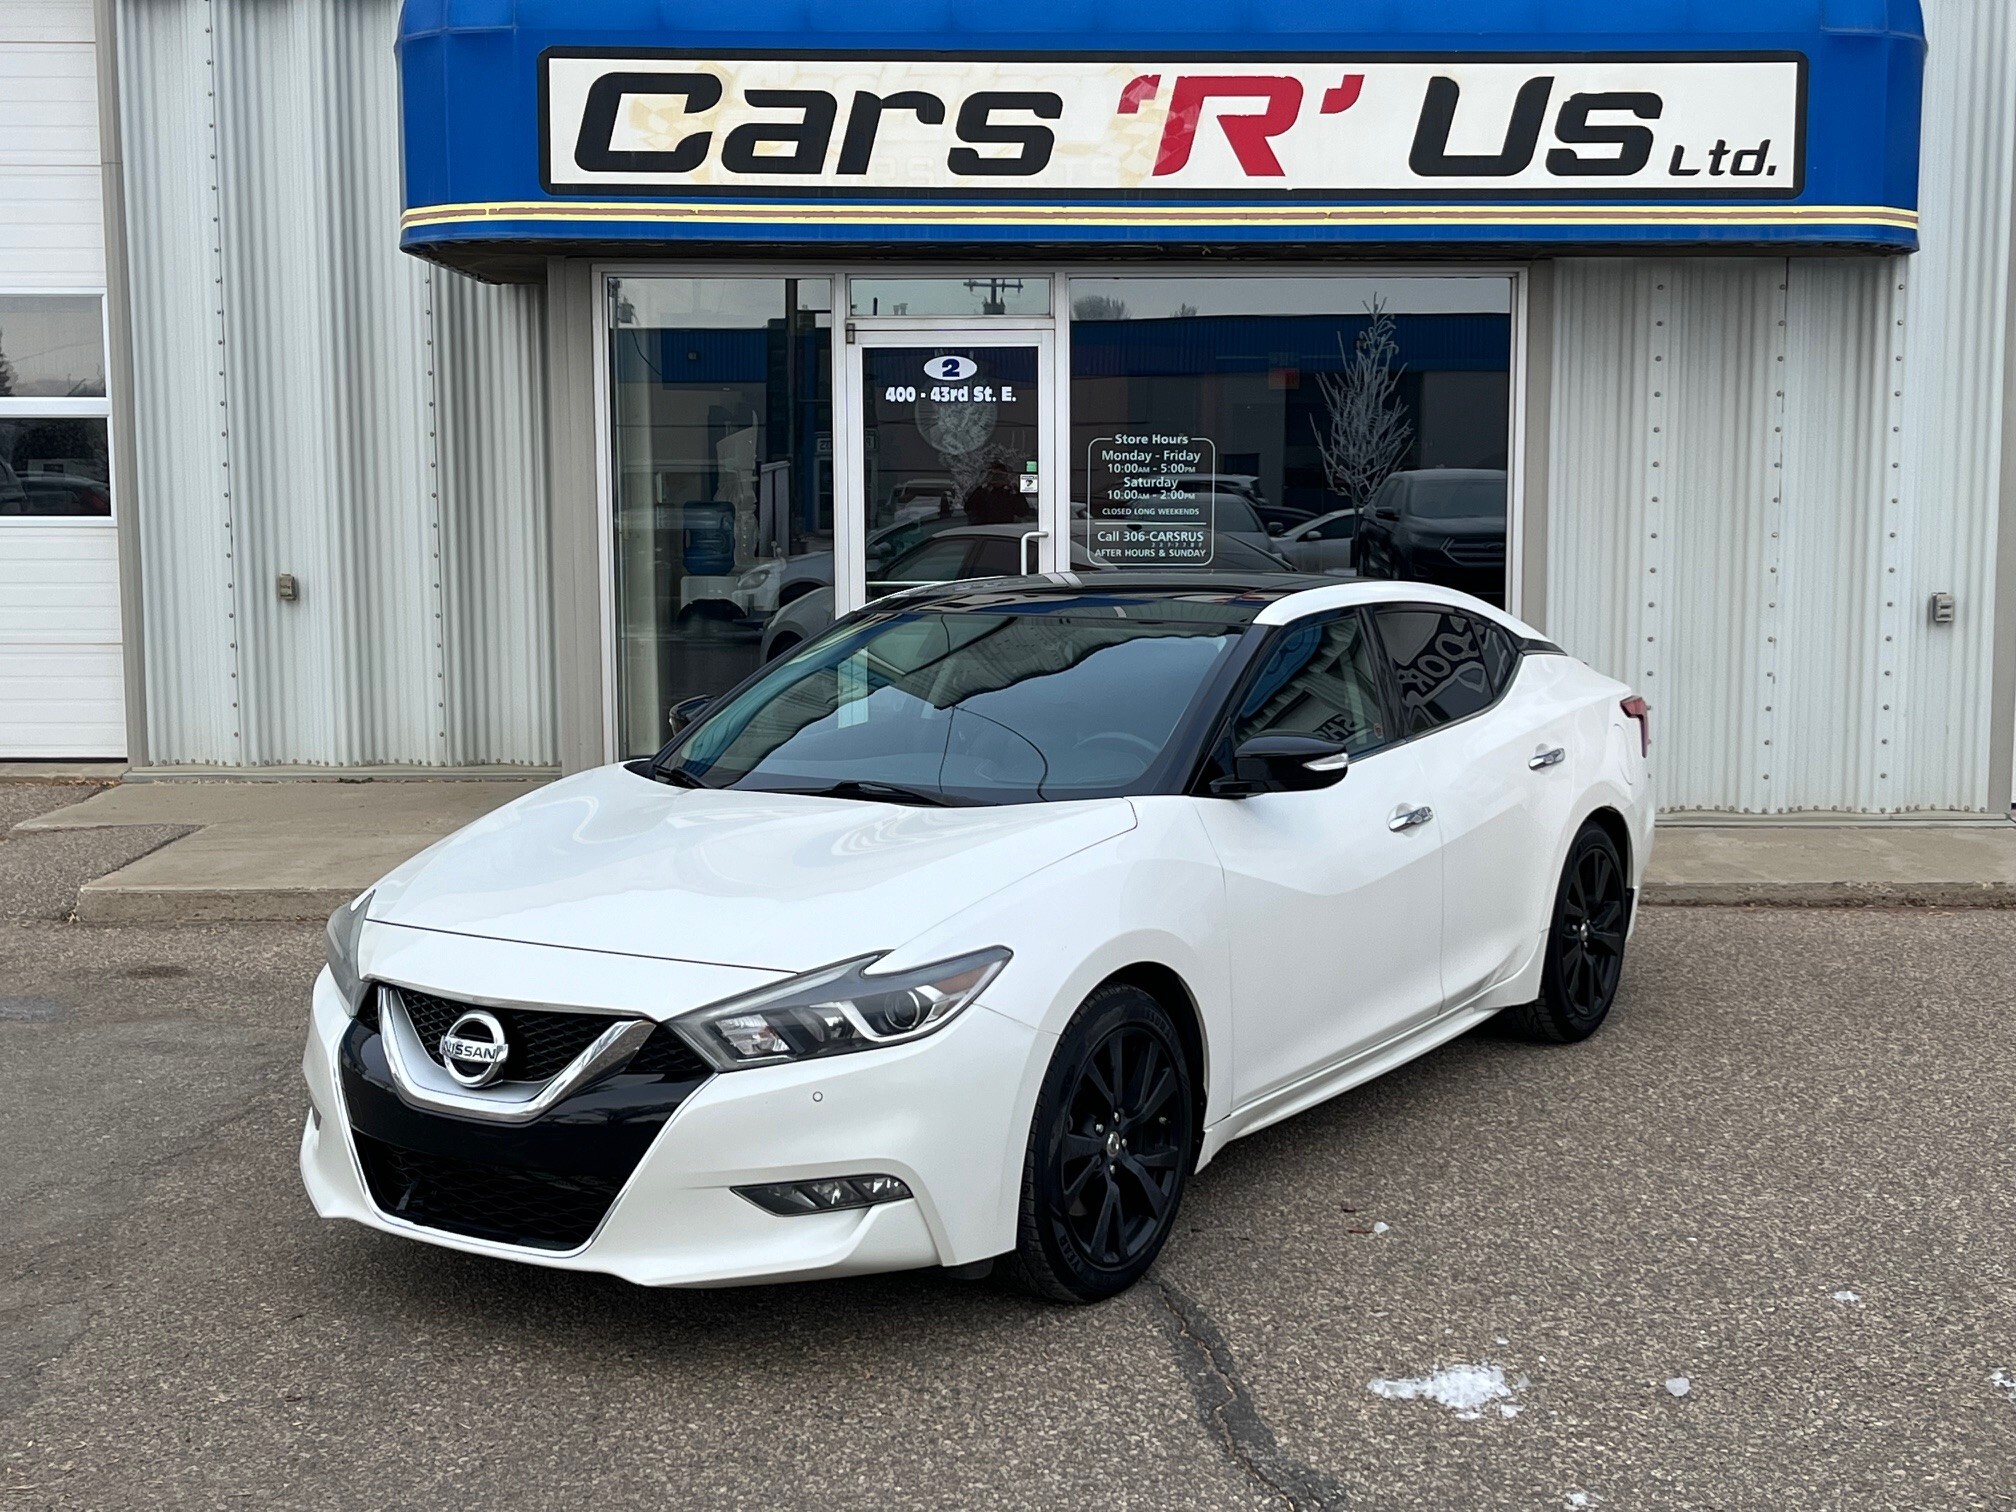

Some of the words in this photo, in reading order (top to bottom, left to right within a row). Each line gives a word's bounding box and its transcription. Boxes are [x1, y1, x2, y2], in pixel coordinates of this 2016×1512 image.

[574, 72, 1064, 177] Cars
[1408, 75, 1664, 177] Us
[1668, 138, 1778, 177] Ltd.
[941, 358, 960, 377] 2
[885, 386, 916, 402] 400
[930, 385, 969, 402] 43rd
[973, 385, 997, 402] St.
[1001, 386, 1017, 402] E.
[1114, 434, 1149, 444] Store
[1152, 434, 1189, 444] Hours
[1101, 450, 1153, 463] Monday
[1163, 449, 1201, 463] Friday
[1107, 463, 1150, 473] 10:00AM
[1160, 463, 1196, 473] 5:00PM
[1123, 476, 1179, 489] Saturday
[1107, 490, 1150, 500] 10:00AM
[1160, 490, 1196, 500] 2:00PM
[1102, 507, 1132, 515] CLOSED
[1133, 507, 1156, 515] LONG
[1157, 507, 1200, 515] WEEKENDS
[1097, 531, 1119, 542] Call
[1123, 531, 1204, 542] 306-CARSRUS
[1095, 549, 1122, 557] AFTER
[1124, 549, 1156, 557] HOURS
[1158, 549, 1166, 557] &
[1169, 549, 1206, 557] SUNDAY
[444, 1040, 497, 1060] NISSAN
